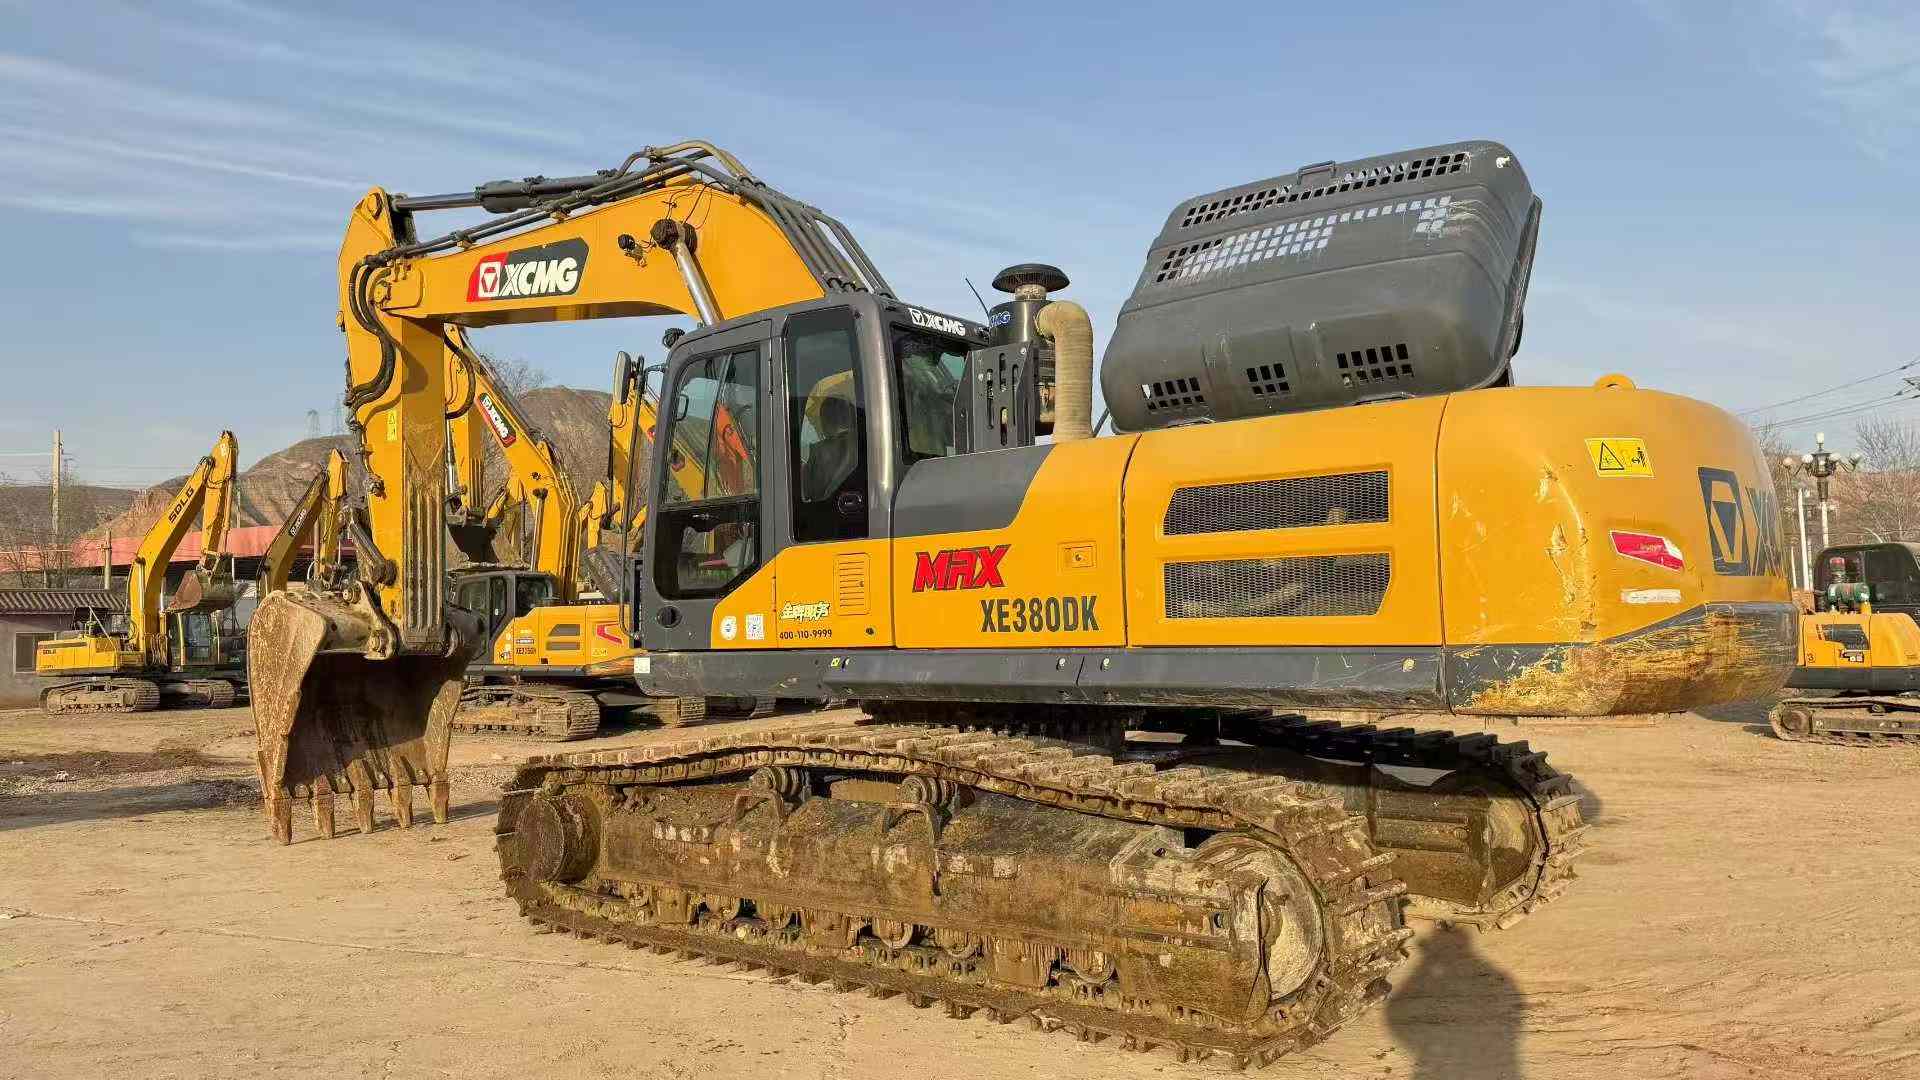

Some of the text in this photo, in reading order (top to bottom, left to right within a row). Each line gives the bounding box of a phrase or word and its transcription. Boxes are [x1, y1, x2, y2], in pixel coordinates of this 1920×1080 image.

[501, 256, 579, 297] XCMG
[923, 312, 966, 337] XCMG
[488, 404, 509, 438] XCMG
[912, 544, 1012, 593] MAX
[981, 595, 1099, 633] XE380DK
[779, 629, 832, 640] 400-110-9999
